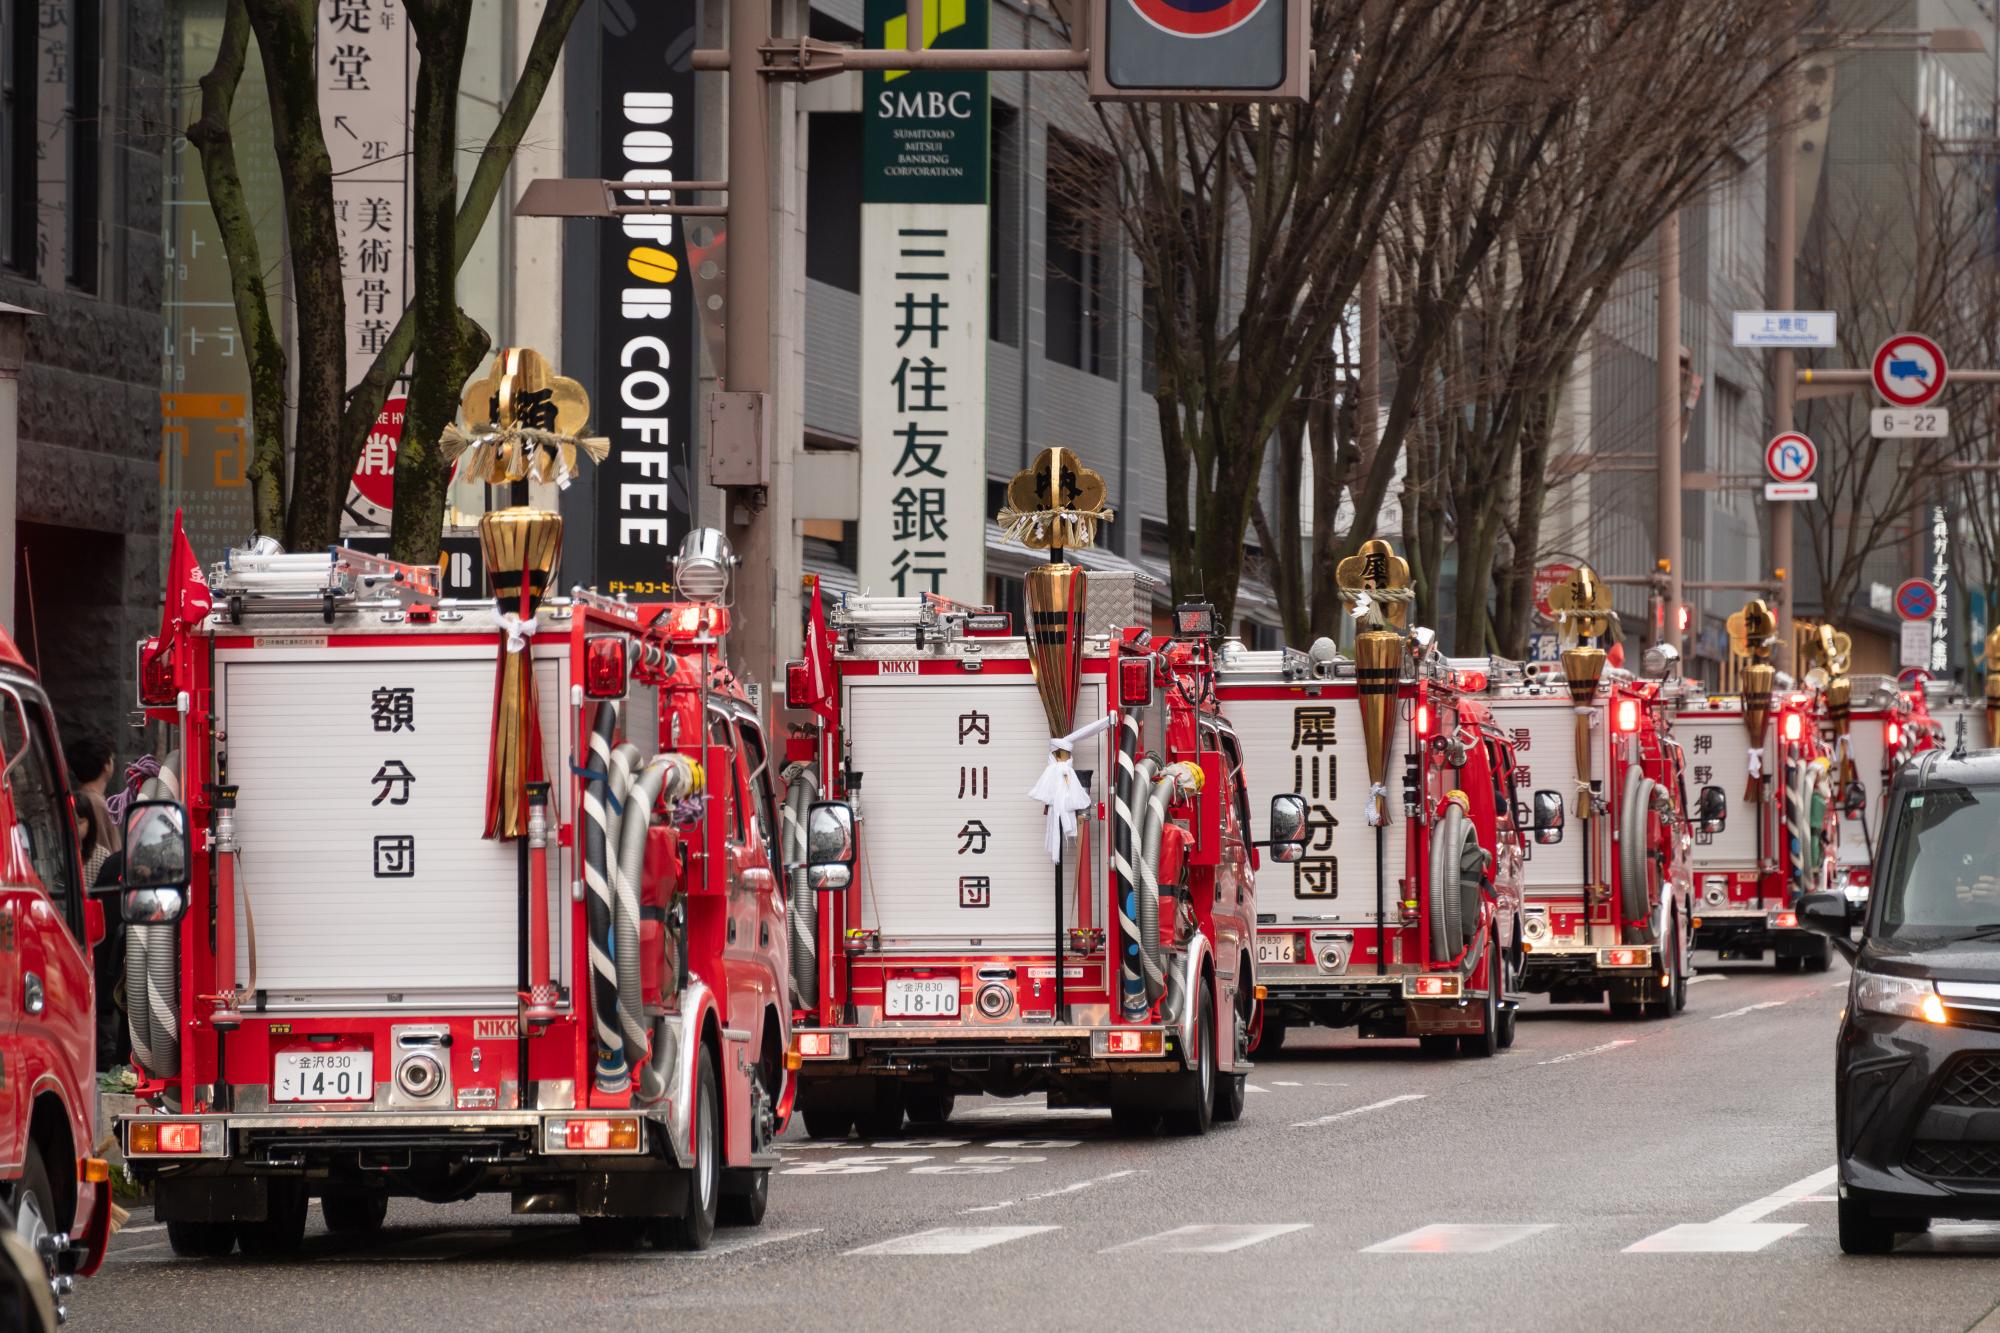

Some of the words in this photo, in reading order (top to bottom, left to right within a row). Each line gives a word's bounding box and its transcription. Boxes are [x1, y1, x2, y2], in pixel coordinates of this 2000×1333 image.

[878, 90, 972, 119] SMBC
[893, 129, 955, 140] SUMITOMO
[361, 141, 389, 160] 2F
[904, 142, 944, 152] MITSUI
[898, 154, 950, 165] BANKING
[884, 166, 964, 177] CORPORATION
[355, 197, 393, 355] 美術骨董
[890, 229, 949, 598] 三井住友銀行
[619, 335, 671, 546] COFFEE
[881, 661, 917, 673] NIKKI
[370, 685, 417, 879] 額分団
[957, 709, 992, 909] 内川分団
[1291, 706, 1339, 900] 犀川分団
[1259, 946, 1291, 961] 0-16
[904, 994, 954, 1012] 18-10
[478, 1020, 518, 1036] NIKK
[299, 1071, 363, 1096] 14-01
